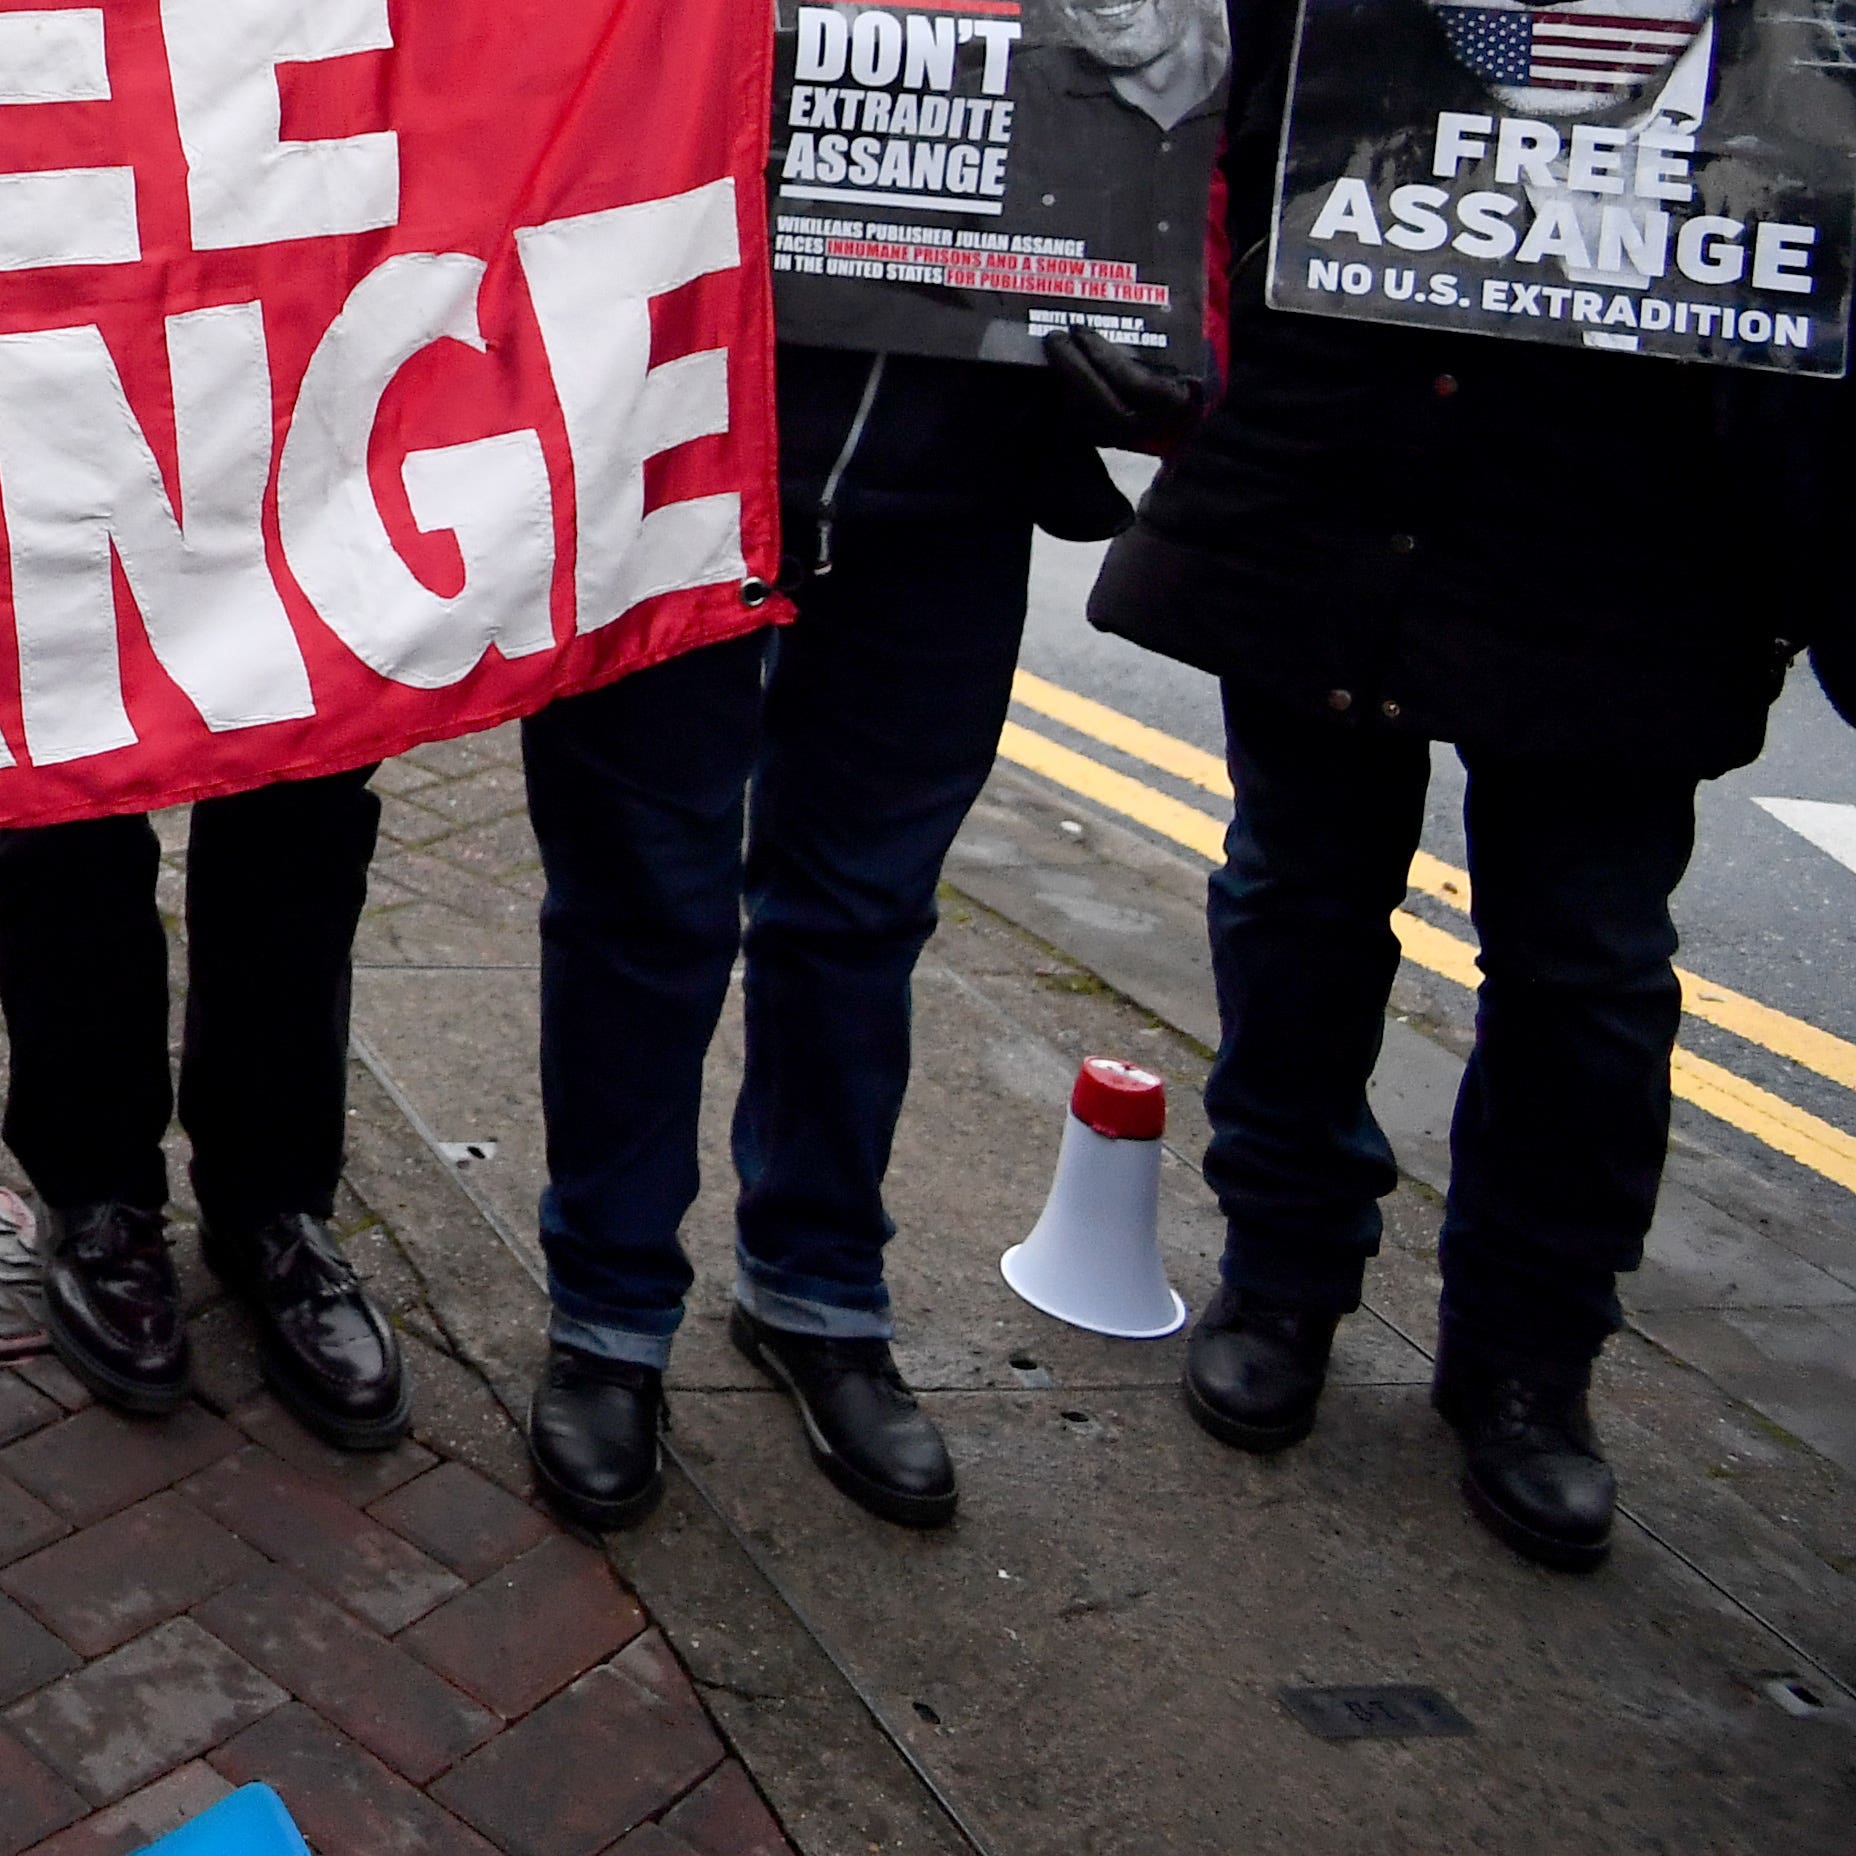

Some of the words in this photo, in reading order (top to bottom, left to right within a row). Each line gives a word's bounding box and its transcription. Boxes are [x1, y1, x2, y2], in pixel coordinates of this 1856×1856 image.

[794, 6, 1022, 95] DON'T
[788, 84, 1015, 143] EXTRADITE
[781, 131, 1009, 196] ASSANGE
[1432, 111, 1696, 203] FREE
[775, 234, 824, 254] FACES
[827, 239, 909, 261] INHUMANE
[913, 247, 982, 267] PRISONS
[986, 253, 1019, 271] AND
[1021, 256, 1032, 272] A
[1035, 258, 1085, 277] SHOW
[1089, 261, 1134, 281] TRIAL
[777, 215, 863, 239] WIKILEAKS
[865, 222, 954, 246] PUBLISHER
[955, 230, 1009, 251] JULIAN
[1010, 235, 1085, 257] ASSANGE
[1309, 177, 1816, 295] ASSANGE
[774, 253, 792, 271] IN
[794, 255, 824, 274] THE
[826, 258, 884, 280] UNITED
[886, 263, 943, 285] STATES
[945, 268, 976, 286] FOR
[979, 271, 1076, 295] PUBLISHING
[1080, 280, 1108, 298] THE
[1113, 284, 1167, 303] TRUTH
[1307, 258, 1373, 295] NO
[1383, 267, 1470, 308] U.S.
[1481, 279, 1810, 349] EXTRADITION
